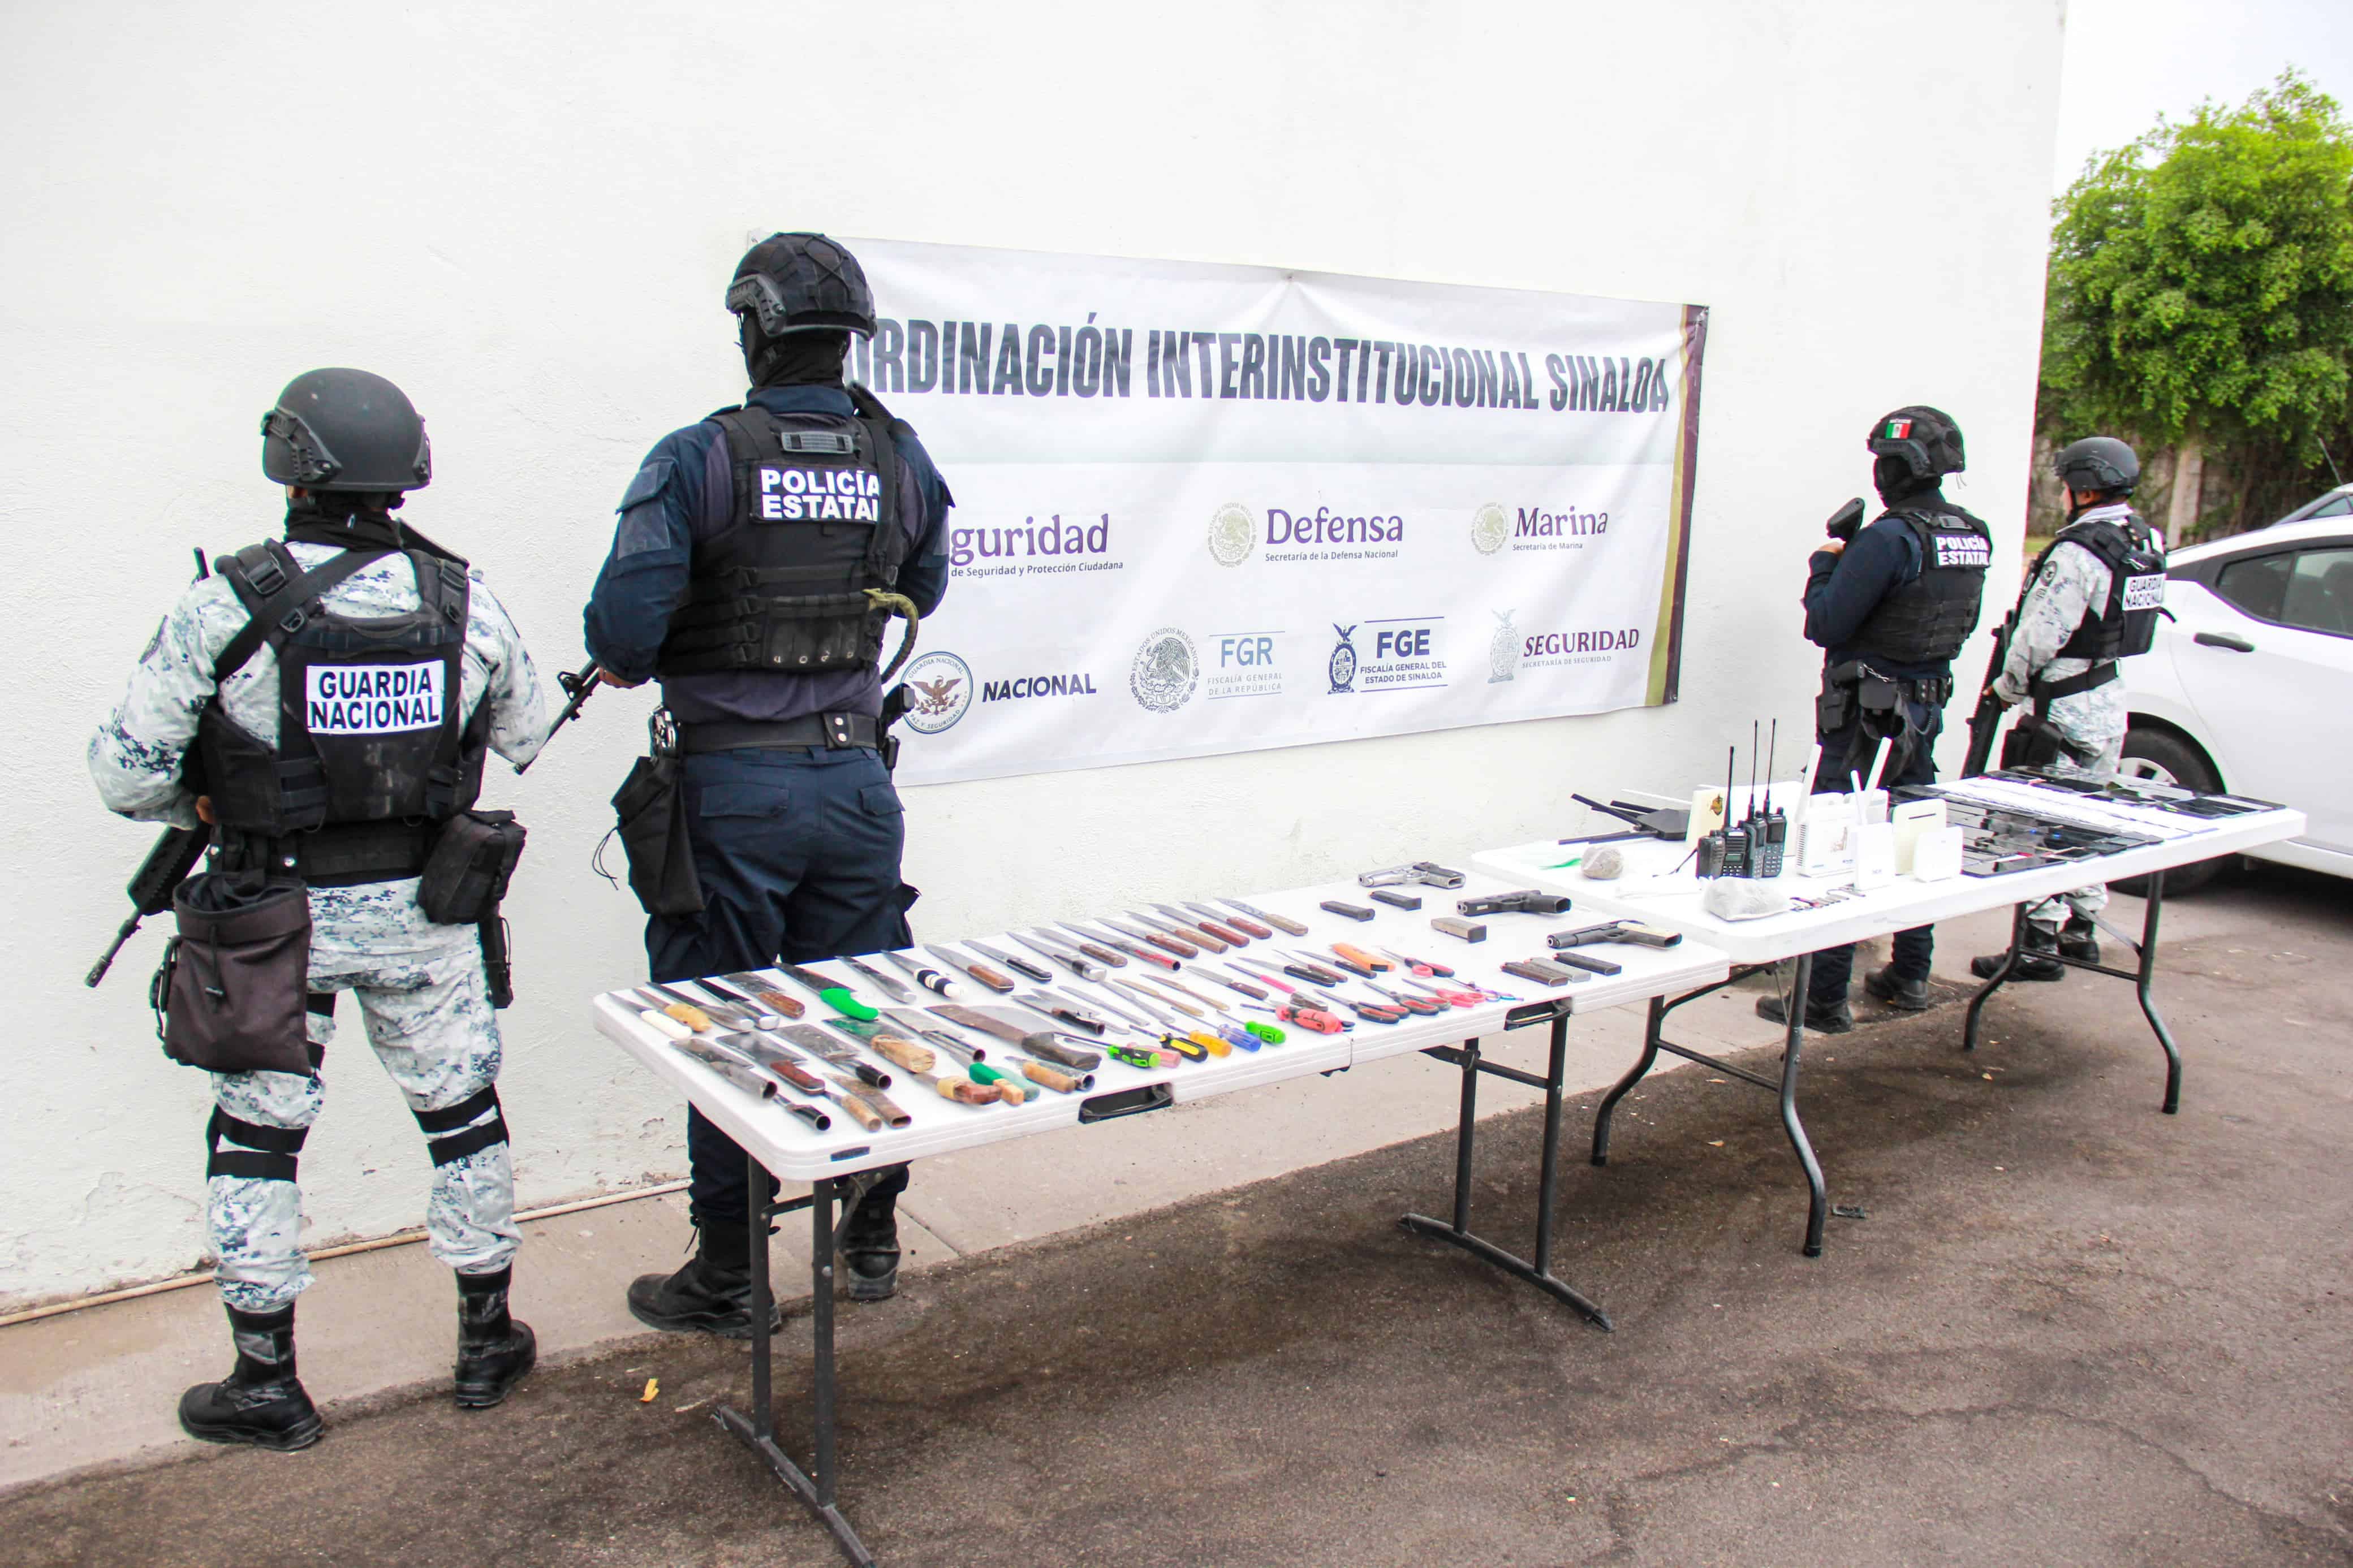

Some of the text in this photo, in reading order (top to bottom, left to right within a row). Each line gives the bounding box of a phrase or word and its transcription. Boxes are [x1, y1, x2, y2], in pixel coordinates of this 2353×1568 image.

[1147, 330, 1539, 410] INTERINSTITUCIONAL
[1545, 353, 1669, 413] SINALOA
[761, 469, 880, 496] POLICÍA
[1266, 506, 1403, 545] Defensa
[1514, 506, 1608, 537] Marina
[950, 513, 1108, 566] guridad
[951, 561, 1123, 578] de Seguridad y Protección Ciudadana
[1265, 549, 1398, 561] Secretaría de la Defensa Nacional
[1150, 628, 1175, 639] UNIDOS
[1376, 629, 1430, 658] FGE
[1523, 628, 1639, 658] SEGURIDAD
[1221, 637, 1273, 667] FGR
[908, 658, 964, 679] GUARDIA NACIONAL
[1246, 672, 1282, 681] GENERAL
[1360, 661, 1447, 674] FISCALÍA GENERAL DEL
[1365, 672, 1442, 684] ESTADO DE SINALOA
[319, 668, 433, 699] GUARDIA
[982, 673, 1097, 702] NACIONAL
[310, 696, 439, 729] NACIONAL
[928, 709, 960, 729] SEGURIDAD
